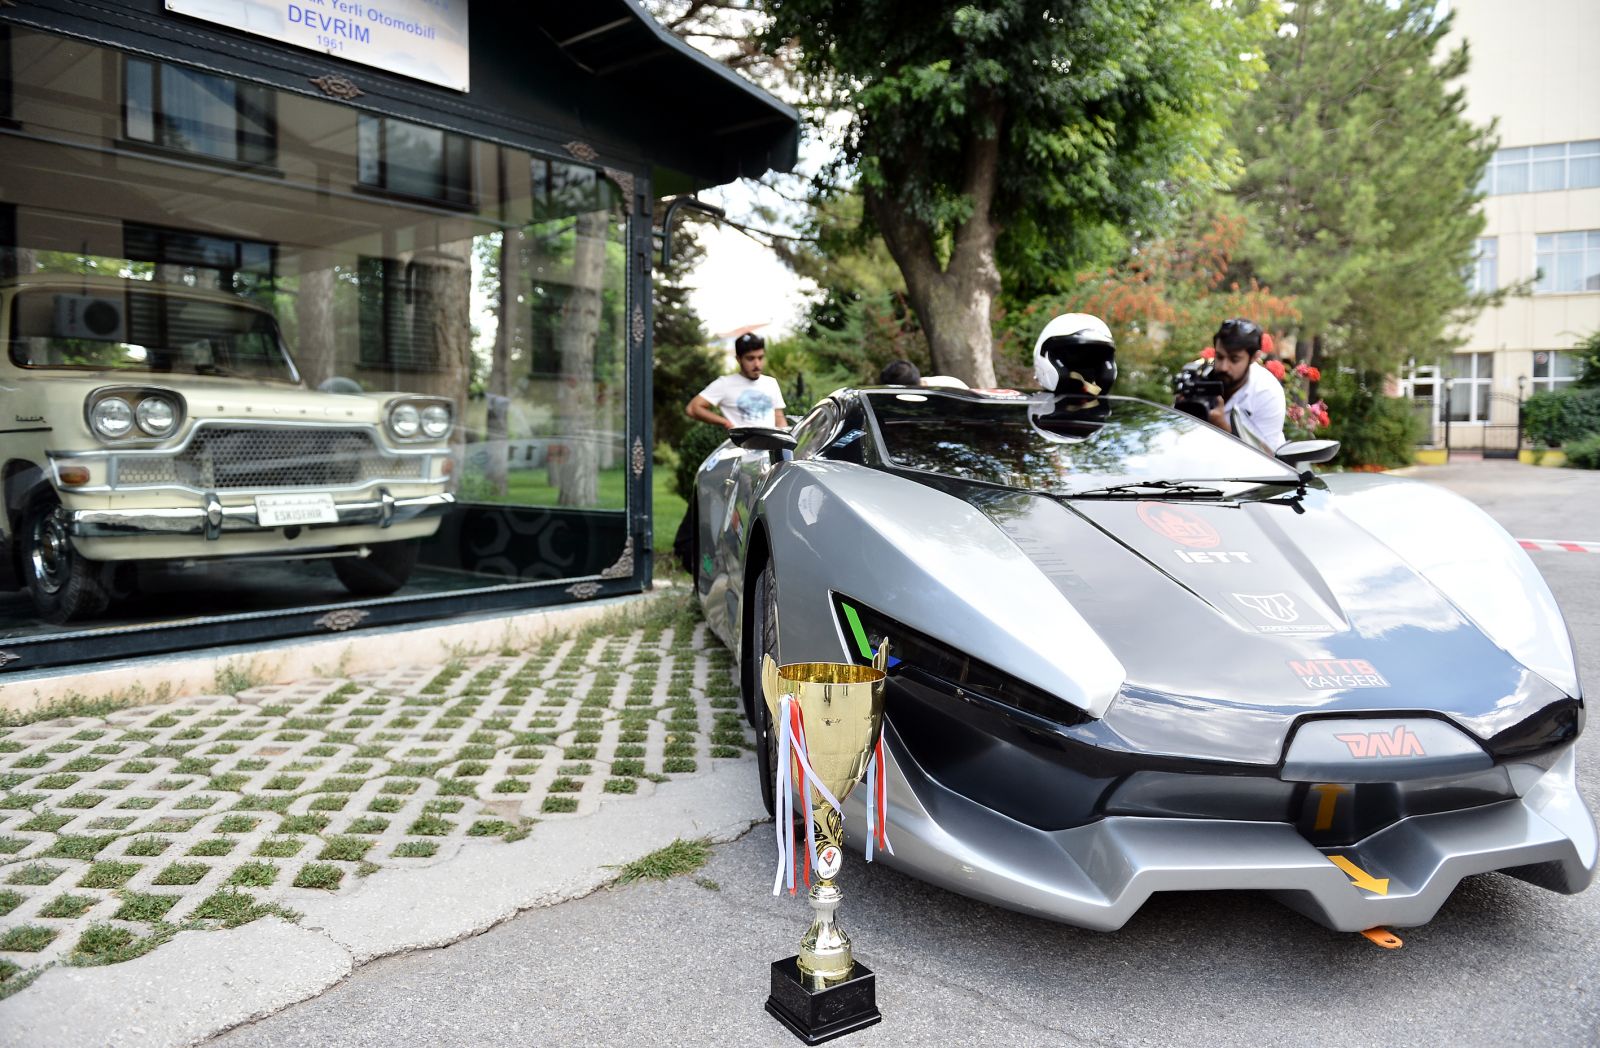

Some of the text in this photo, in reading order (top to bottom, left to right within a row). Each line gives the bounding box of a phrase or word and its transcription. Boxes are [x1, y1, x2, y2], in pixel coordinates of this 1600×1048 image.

[288, 4, 370, 44] DEVRİM
[331, 0, 436, 40] Yerli Otomobili
[317, 34, 343, 51] 1961
[1287, 659, 1377, 676] MTTB
